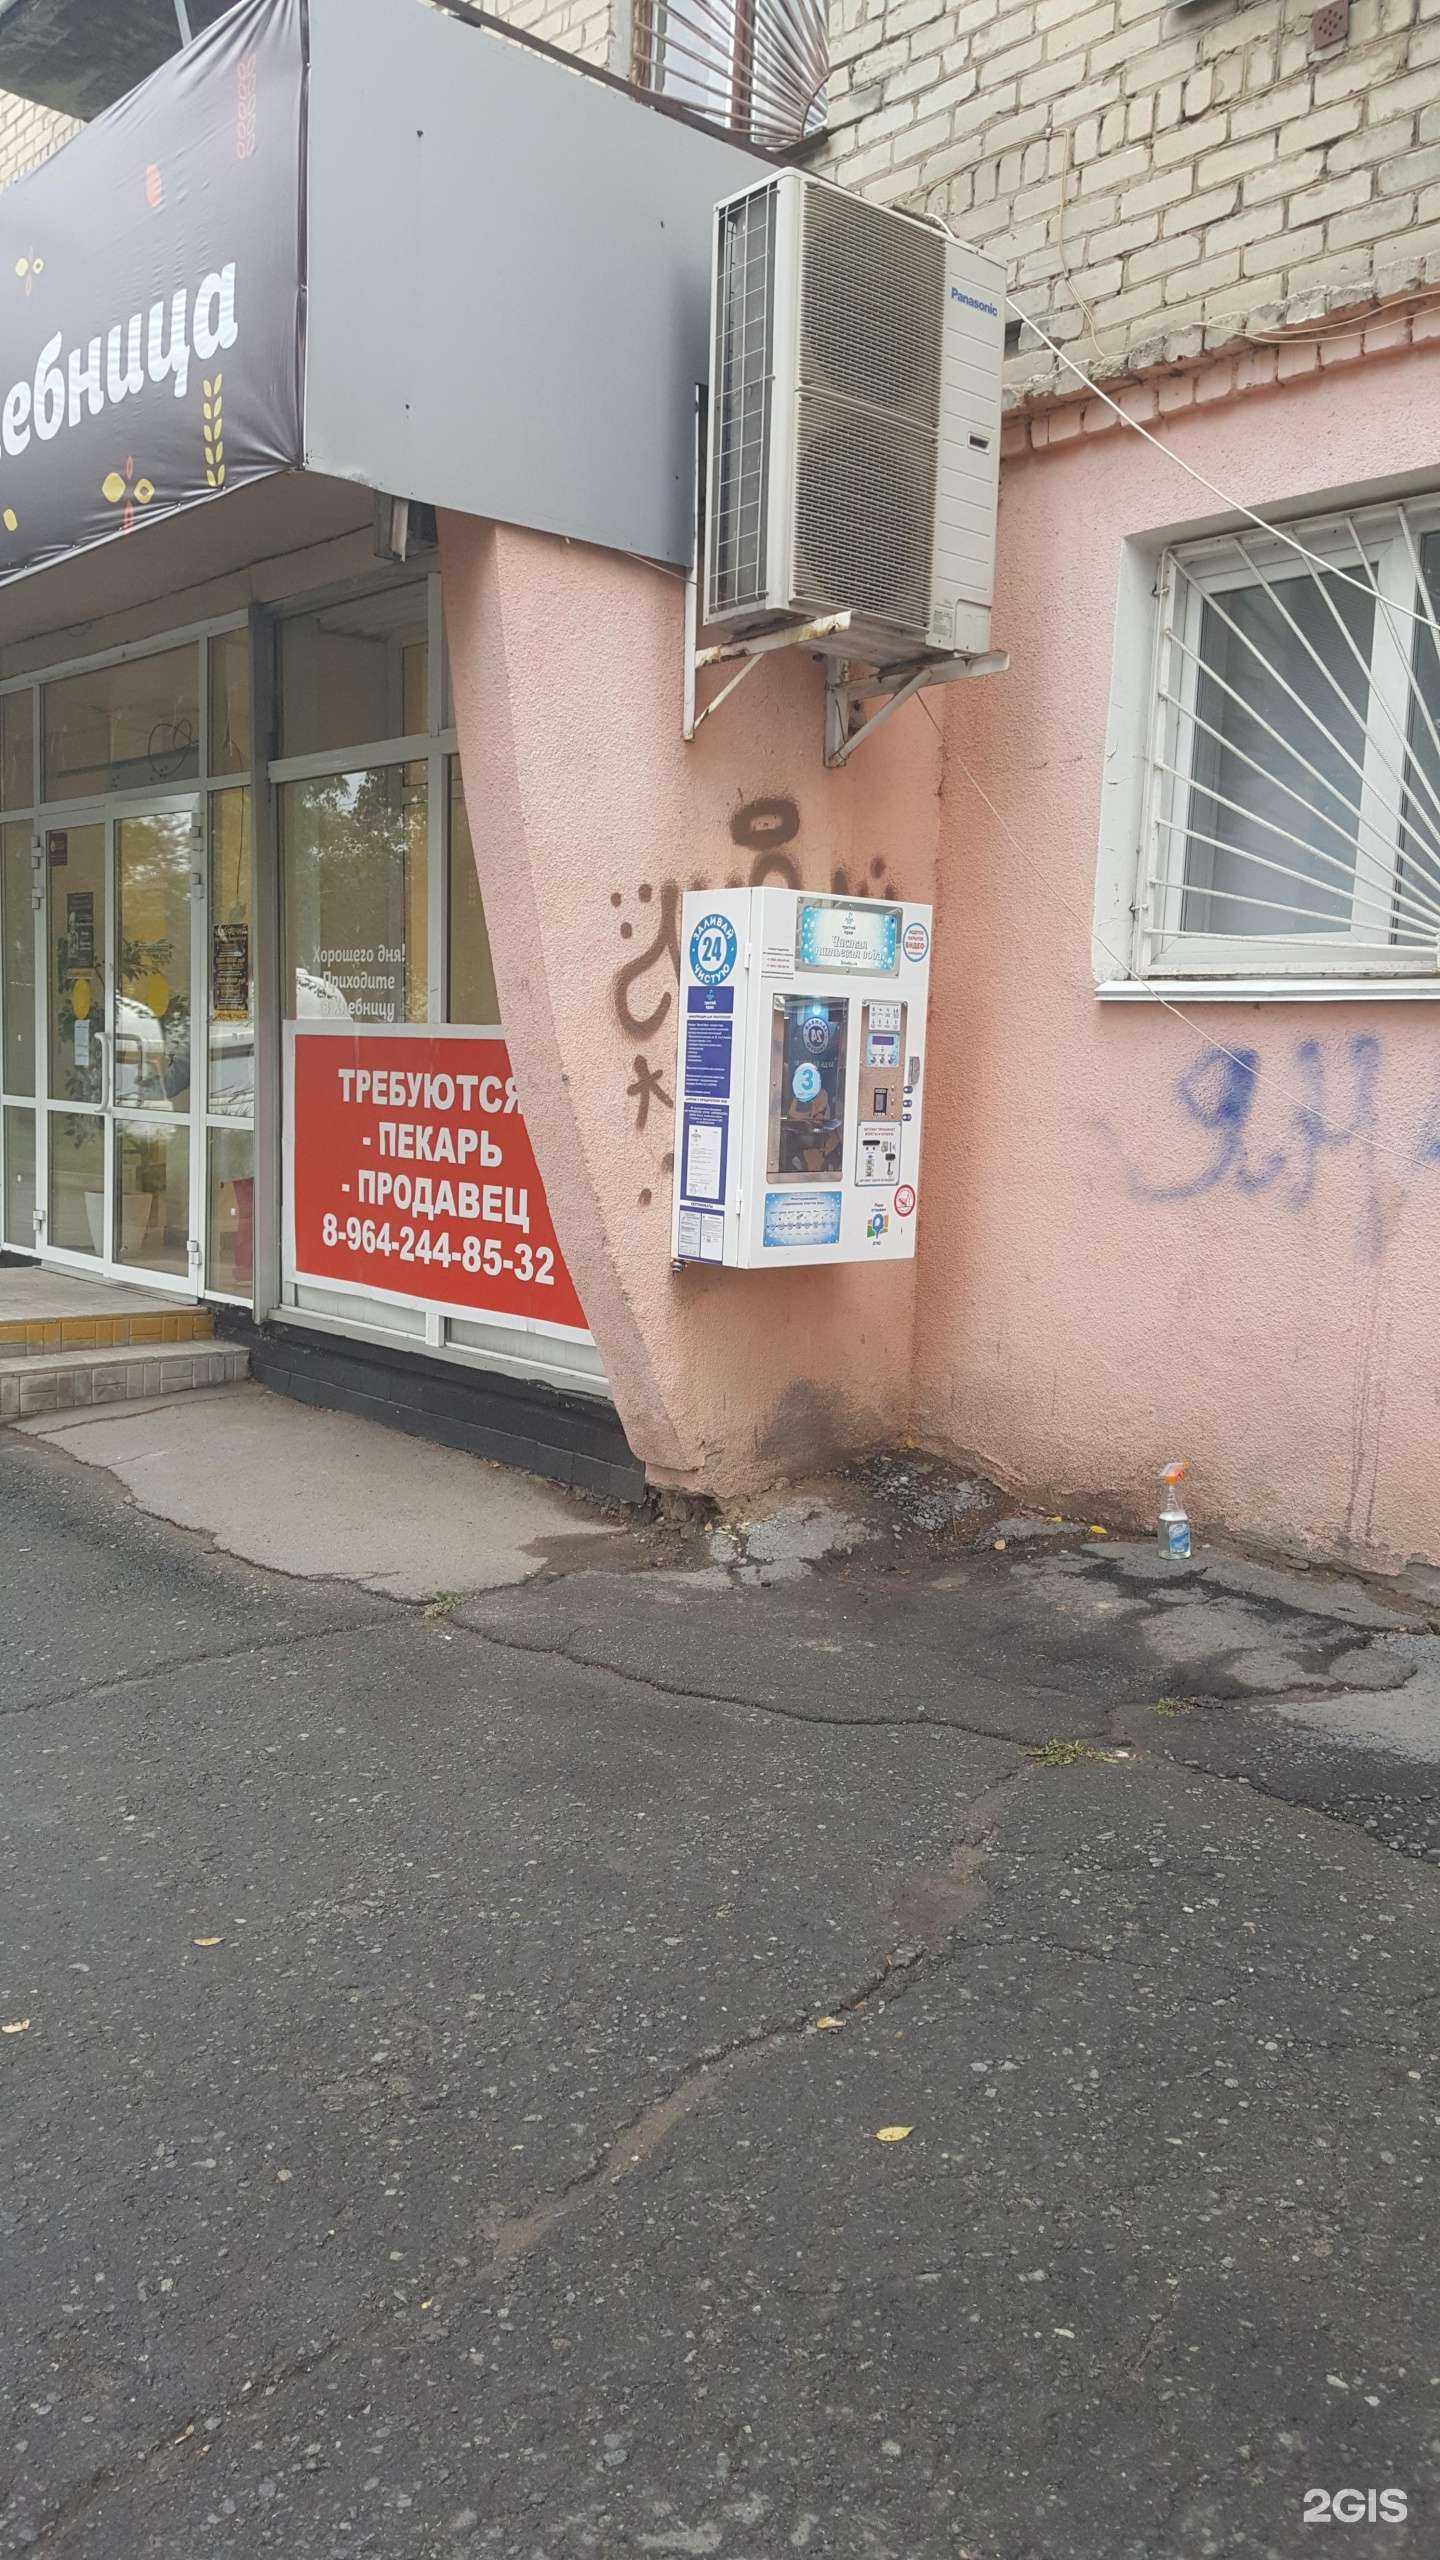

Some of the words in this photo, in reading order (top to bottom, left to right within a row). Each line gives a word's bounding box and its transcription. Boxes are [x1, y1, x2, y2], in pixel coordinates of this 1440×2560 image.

[951, 286, 998, 317] Panasonic
[0, 262, 238, 456] ебница
[693, 915, 734, 941] ЗАЛИВАЙ
[313, 945, 373, 967] Хорошего
[377, 944, 406, 962] дня!
[702, 936, 722, 961] 24
[323, 970, 395, 991] Приходите
[694, 963, 730, 984] ЧИСТУЮ
[337, 1068, 523, 1115] ТРЕБУЮТСЯ
[801, 1068, 814, 1091] 3
[378, 1121, 503, 1168] ПЕКАРЬ
[357, 1169, 530, 1234] ПРОДАВЕЦ
[321, 1212, 556, 1286] 8-964-244-85-32
